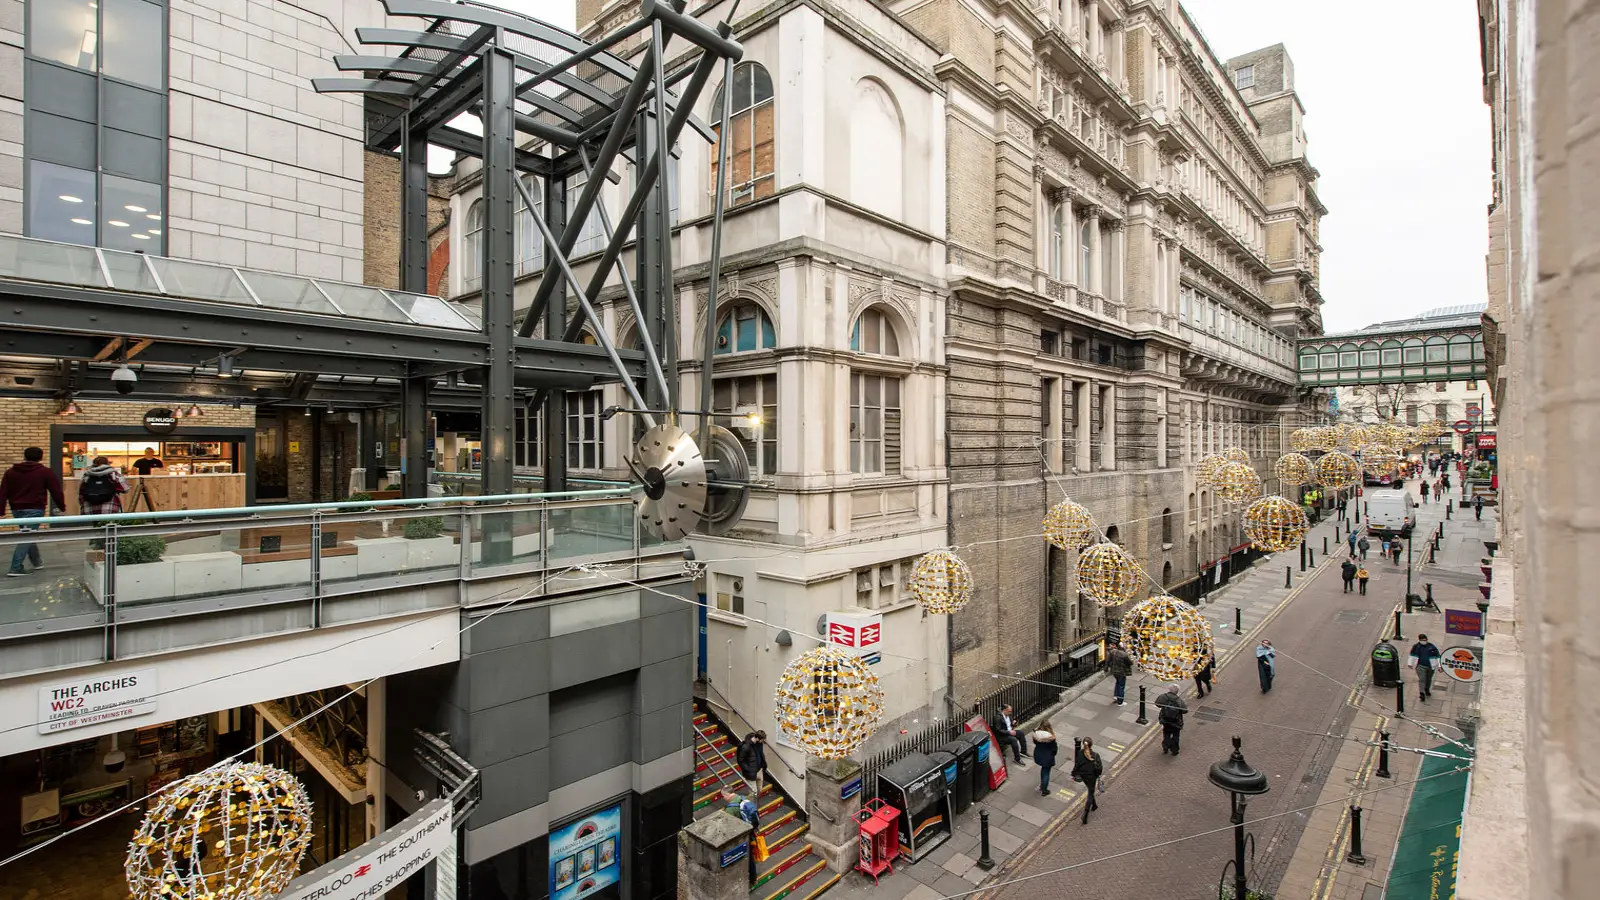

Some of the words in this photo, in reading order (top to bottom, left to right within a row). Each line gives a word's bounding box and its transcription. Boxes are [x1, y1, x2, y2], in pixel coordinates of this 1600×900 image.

[1448, 662, 1480, 672] germa
[51, 686, 78, 700] THE
[82, 676, 137, 695] ARCHES
[49, 709, 79, 720] LEADING
[93, 702, 118, 712] CRAVEN
[51, 697, 84, 712] WC2
[50, 721, 67, 730] CITY
[69, 719, 77, 727] OF
[80, 708, 133, 724] WESTMINSTER
[302, 873, 353, 900] TERLOO
[377, 846, 397, 864] THE
[399, 810, 449, 853] SOUTHBANK
[385, 848, 431, 886] SHOPPING
